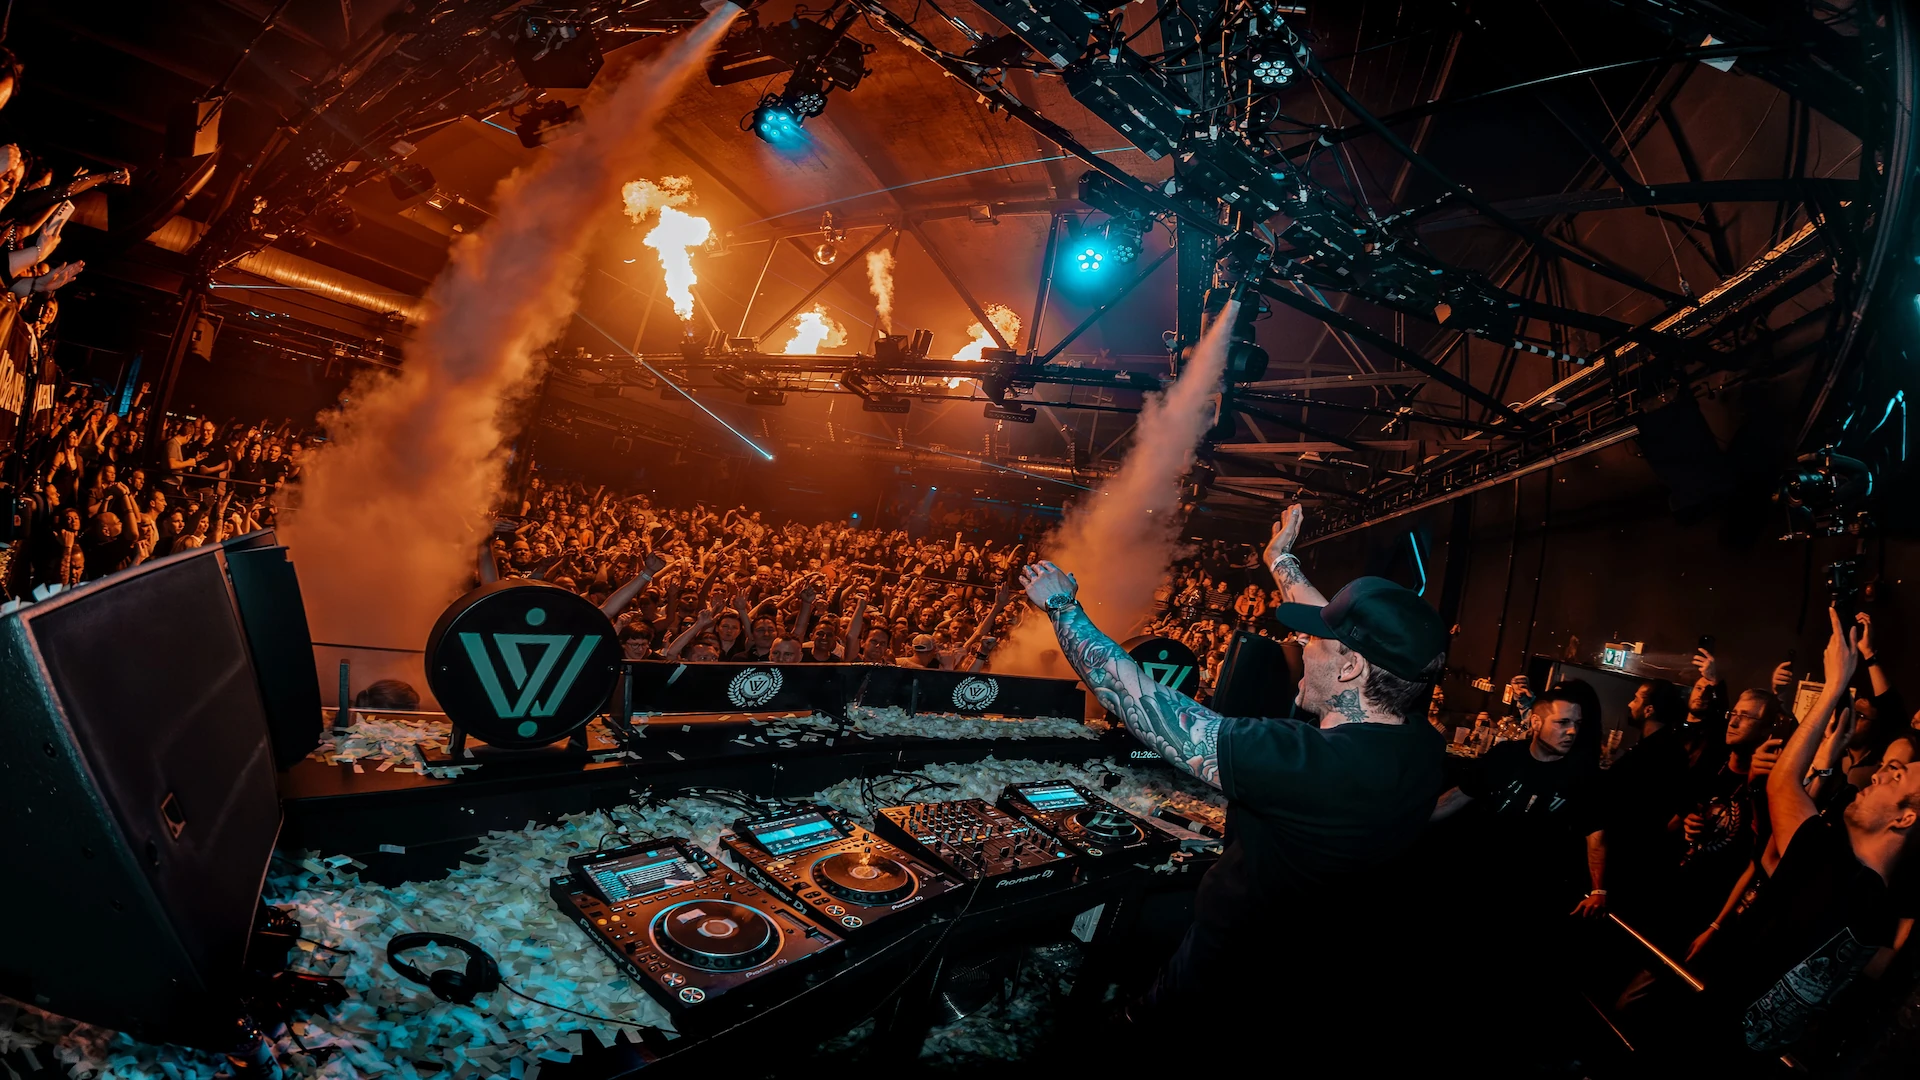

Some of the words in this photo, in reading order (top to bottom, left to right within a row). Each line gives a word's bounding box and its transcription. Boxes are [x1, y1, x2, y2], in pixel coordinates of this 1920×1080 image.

[748, 867, 793, 902] Pioneer
[995, 873, 1041, 888] Pioneer
[580, 918, 625, 963] Pioneer
[745, 963, 776, 979] Pioneer
